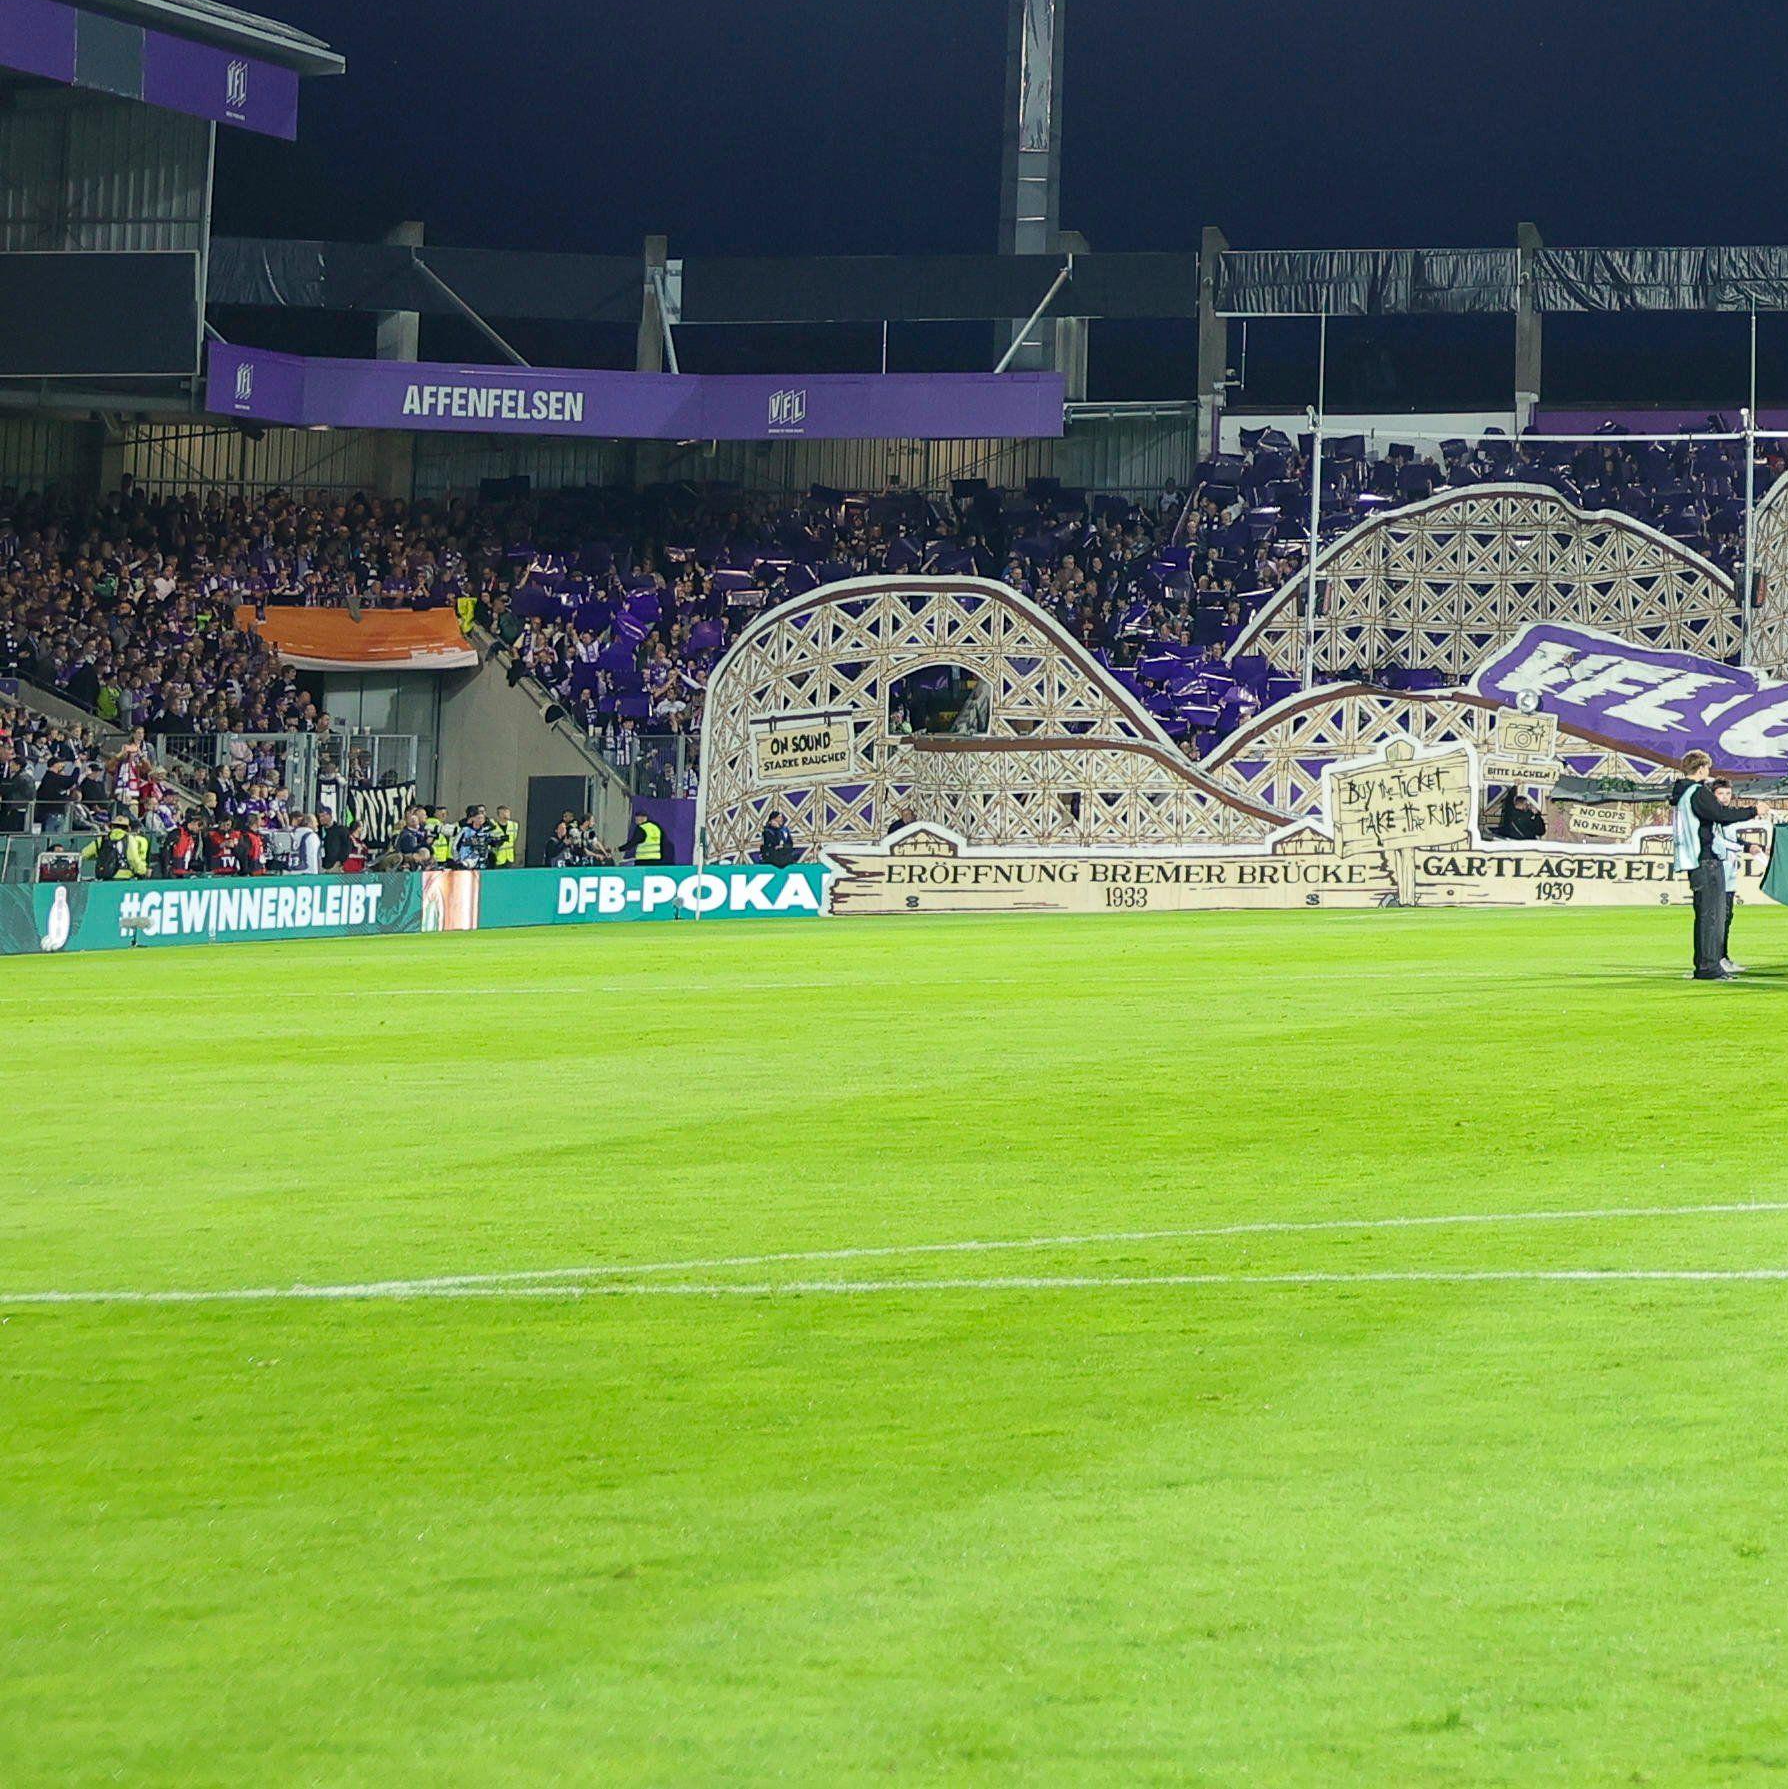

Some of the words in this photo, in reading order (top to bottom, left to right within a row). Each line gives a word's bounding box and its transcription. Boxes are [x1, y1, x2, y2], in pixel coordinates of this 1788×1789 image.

[402, 384, 584, 422] AFFENFELSEN
[768, 389, 806, 424] VFL
[770, 737, 789, 756] ON
[791, 731, 831, 753] SOUND
[763, 758, 800, 771] STARKE
[1487, 767, 1509, 775] BITTE
[1342, 779, 1376, 812] BUY
[1573, 819, 1589, 829] NO
[1580, 807, 1596, 817] NO
[1597, 810, 1626, 820] COPS
[1358, 811, 1396, 846] TAKE
[221, 856, 236, 868] TV
[886, 861, 1080, 884] ERÖFFNUNG
[1090, 863, 1226, 884] BREMER
[1237, 859, 1368, 884] BRÜCKE
[1422, 856, 1618, 880] GARTLAGER
[557, 873, 834, 915] DFB-POKA
[1105, 887, 1149, 908] 1933
[1535, 882, 1574, 901] 1939
[120, 884, 382, 937] #GEWINNERBLEIBT
